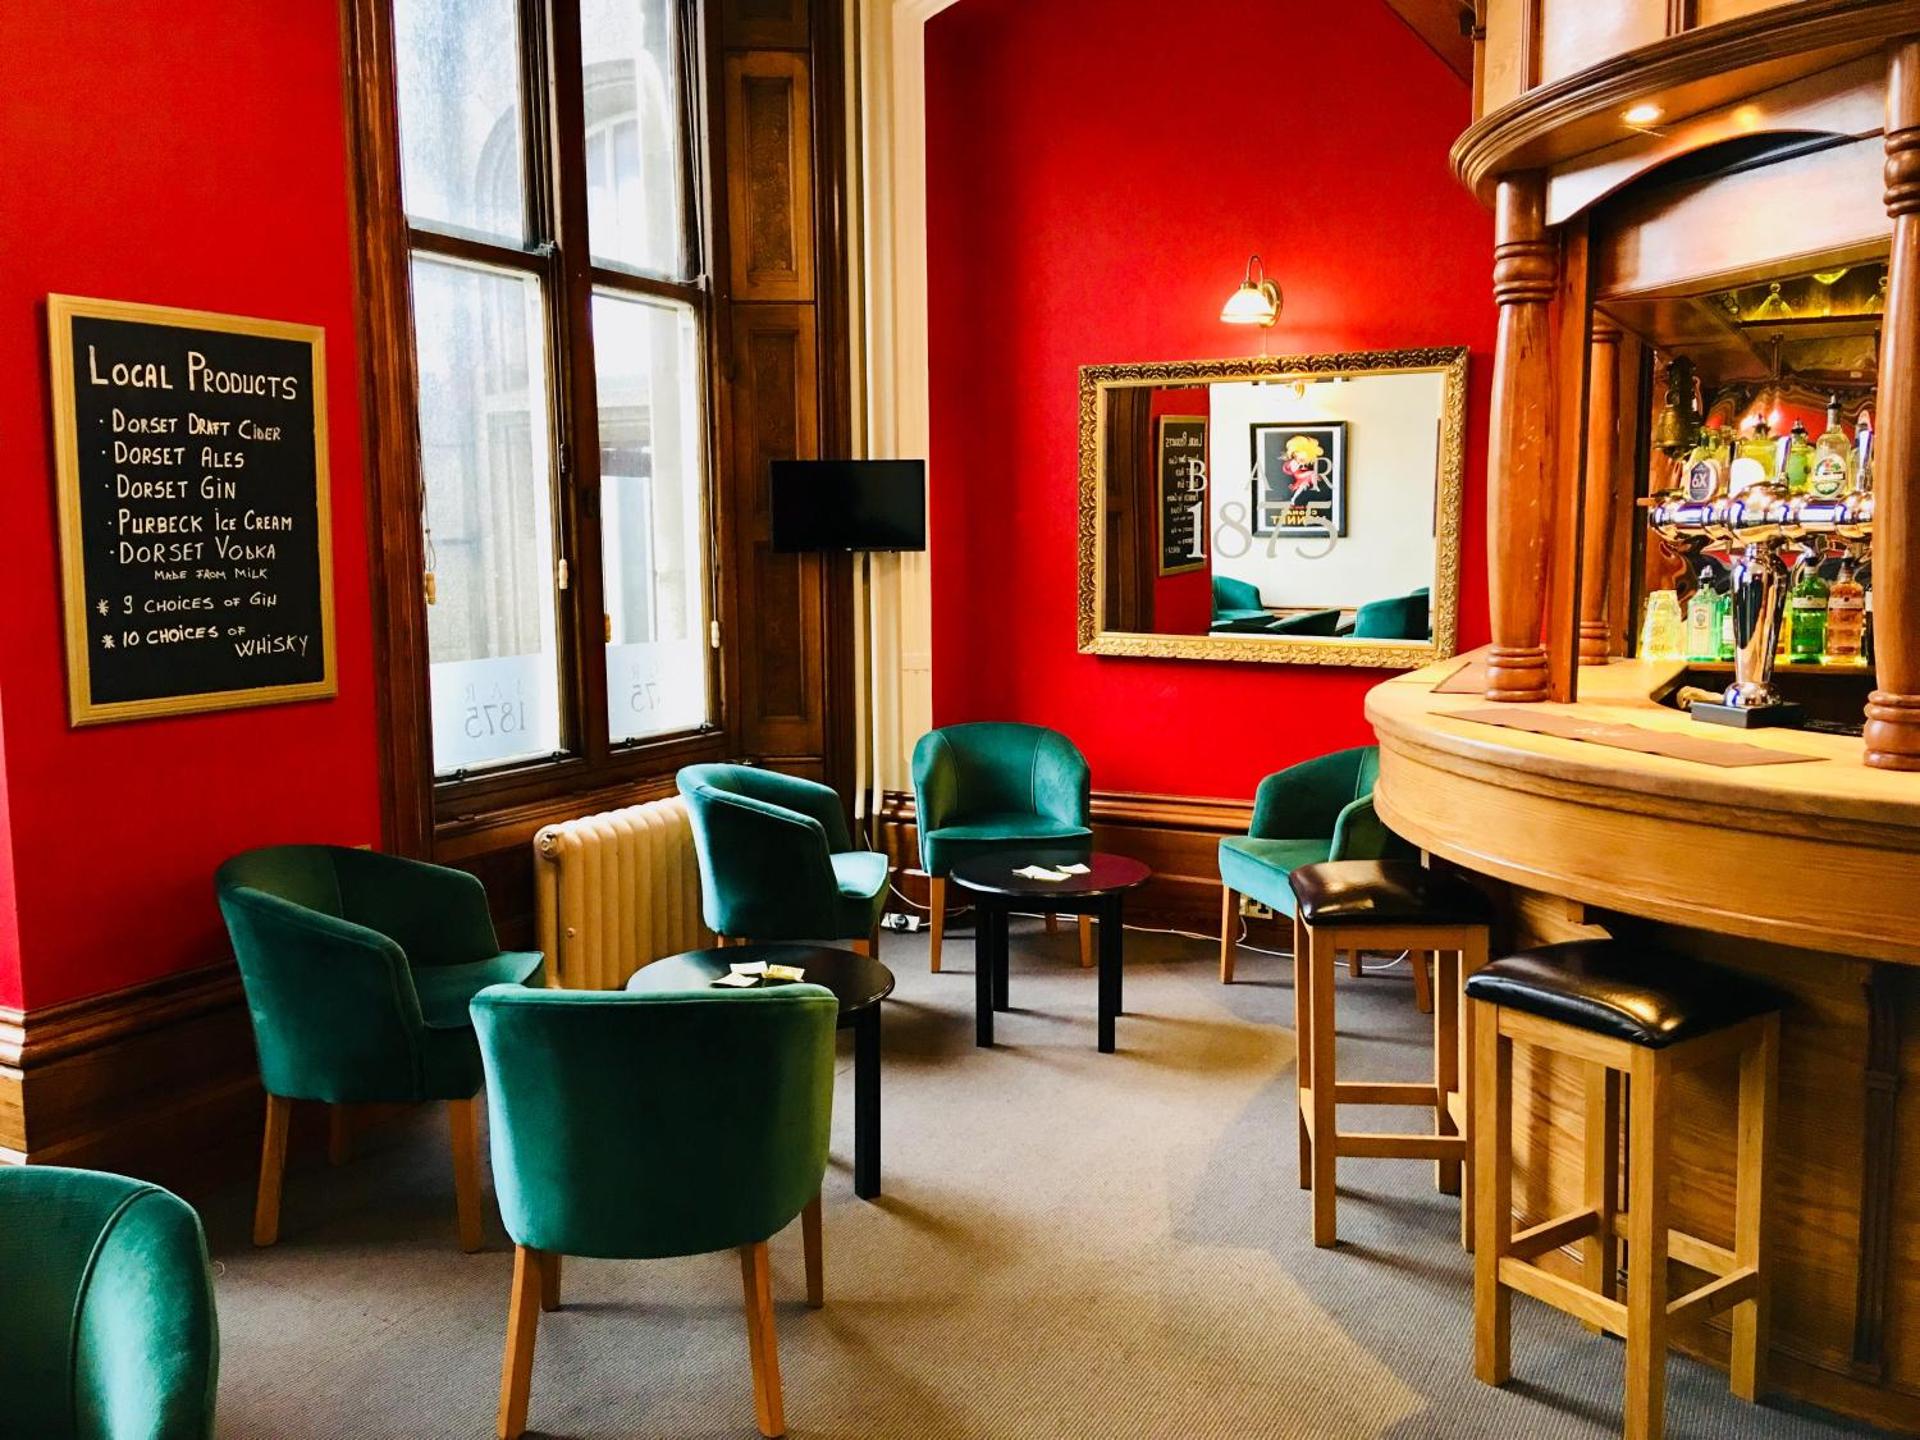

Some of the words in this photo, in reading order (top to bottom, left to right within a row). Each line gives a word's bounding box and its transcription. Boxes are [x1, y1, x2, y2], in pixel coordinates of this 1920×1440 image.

[89, 345, 173, 389] LOCAL
[188, 352, 297, 399] PRODUCTS
[113, 408, 177, 433] DORSET
[189, 413, 230, 435] DRAFT
[115, 441, 185, 465] DORSET
[202, 447, 244, 468] ALES
[117, 474, 188, 498] DORSET
[119, 509, 202, 535] PURBECK
[244, 510, 291, 530] CREAM
[1186, 501, 1338, 559] 1875
[120, 542, 203, 563] DORSET
[215, 535, 275, 560] VODKA
[196, 568, 226, 580] FROM
[124, 596, 132, 614] 9
[224, 597, 241, 607] OF
[123, 631, 139, 647] 10
[228, 626, 246, 636] OF
